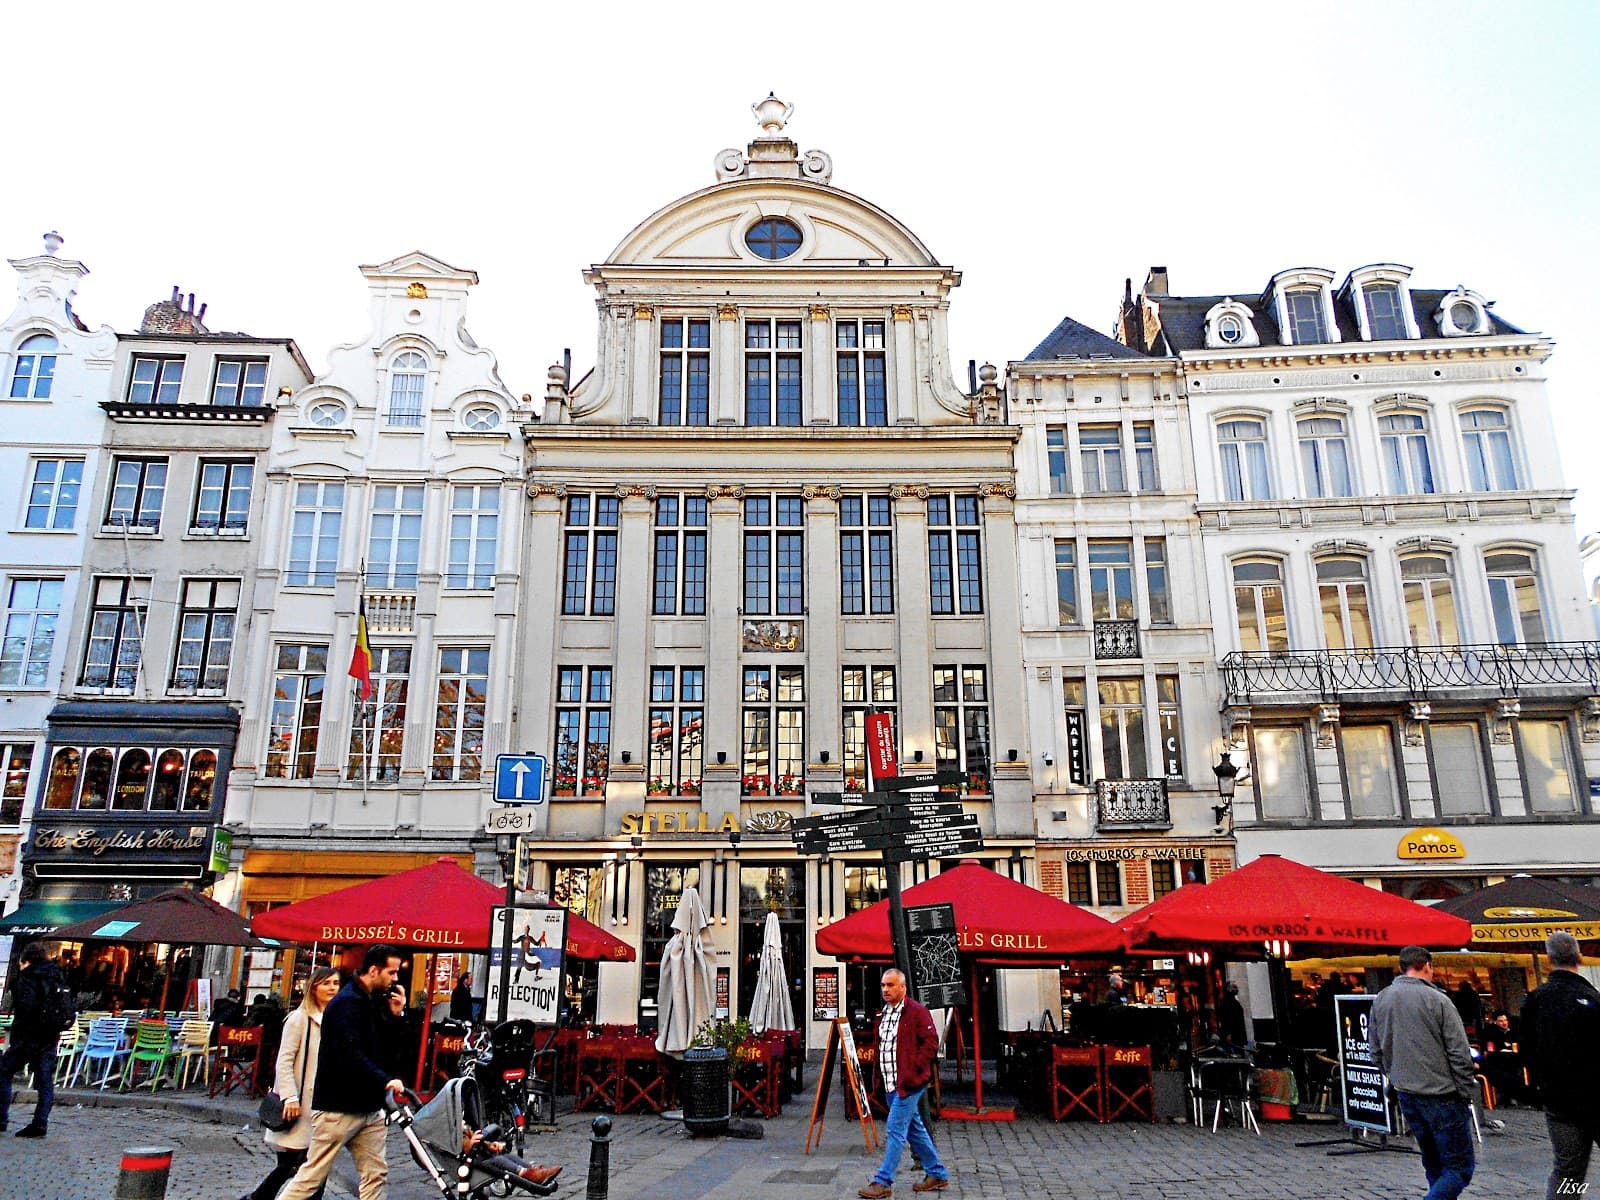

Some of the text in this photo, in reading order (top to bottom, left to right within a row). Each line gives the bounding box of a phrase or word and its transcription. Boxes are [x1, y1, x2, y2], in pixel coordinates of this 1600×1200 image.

[1068, 716, 1081, 781] WAFFLE
[1166, 716, 1178, 775] ICE
[880, 748, 888, 770] Quartier
[189, 770, 215, 778] TAILOR
[117, 785, 145, 793] LONDON
[621, 811, 740, 834] STELLA
[34, 827, 204, 855] The English House
[1408, 842, 1457, 854] Panos
[1066, 850, 1085, 861] LOS
[1141, 849, 1150, 858] &
[1154, 848, 1207, 859] WAFFLE
[322, 926, 464, 945] BRUSSELS GRILL
[1229, 925, 1249, 936] LOS
[1331, 926, 1389, 940] WAFFLE
[1497, 928, 1540, 938] YOUR
[990, 933, 1048, 949] GRILL
[491, 984, 556, 1011] RLECTION
[228, 1029, 253, 1042] Leffe
[1345, 1039, 1356, 1051] ICE
[1113, 1049, 1141, 1063] Leffe
[1347, 1070, 1382, 1085] MILK SHAKE
[1353, 1087, 1378, 1098] chocolate
[1349, 1099, 1360, 1110] only
